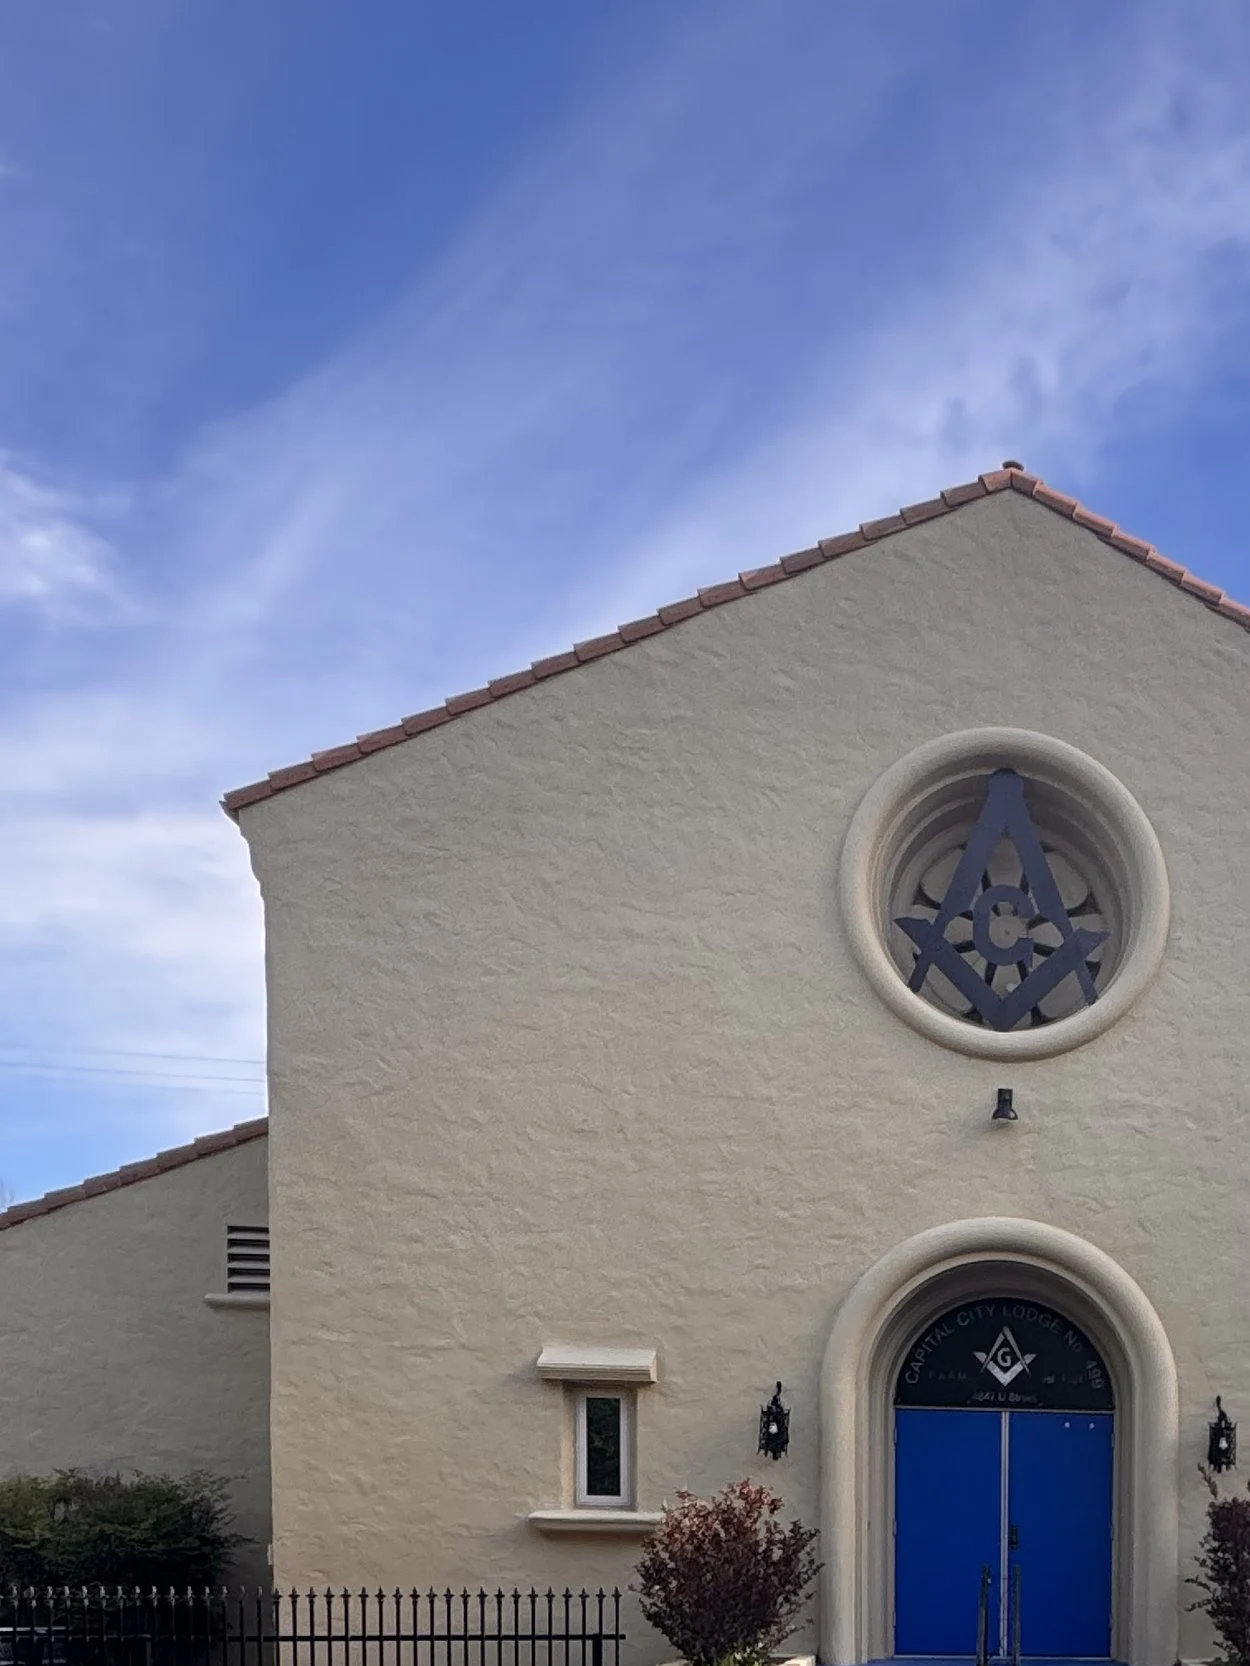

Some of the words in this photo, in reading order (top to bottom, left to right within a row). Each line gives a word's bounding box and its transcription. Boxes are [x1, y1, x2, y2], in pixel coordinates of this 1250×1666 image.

[905, 1324, 955, 1384] CAPITAL
[956, 1305, 996, 1326] CITY
[1002, 1305, 1062, 1334] LODGE
[997, 1348, 1012, 1367] G
